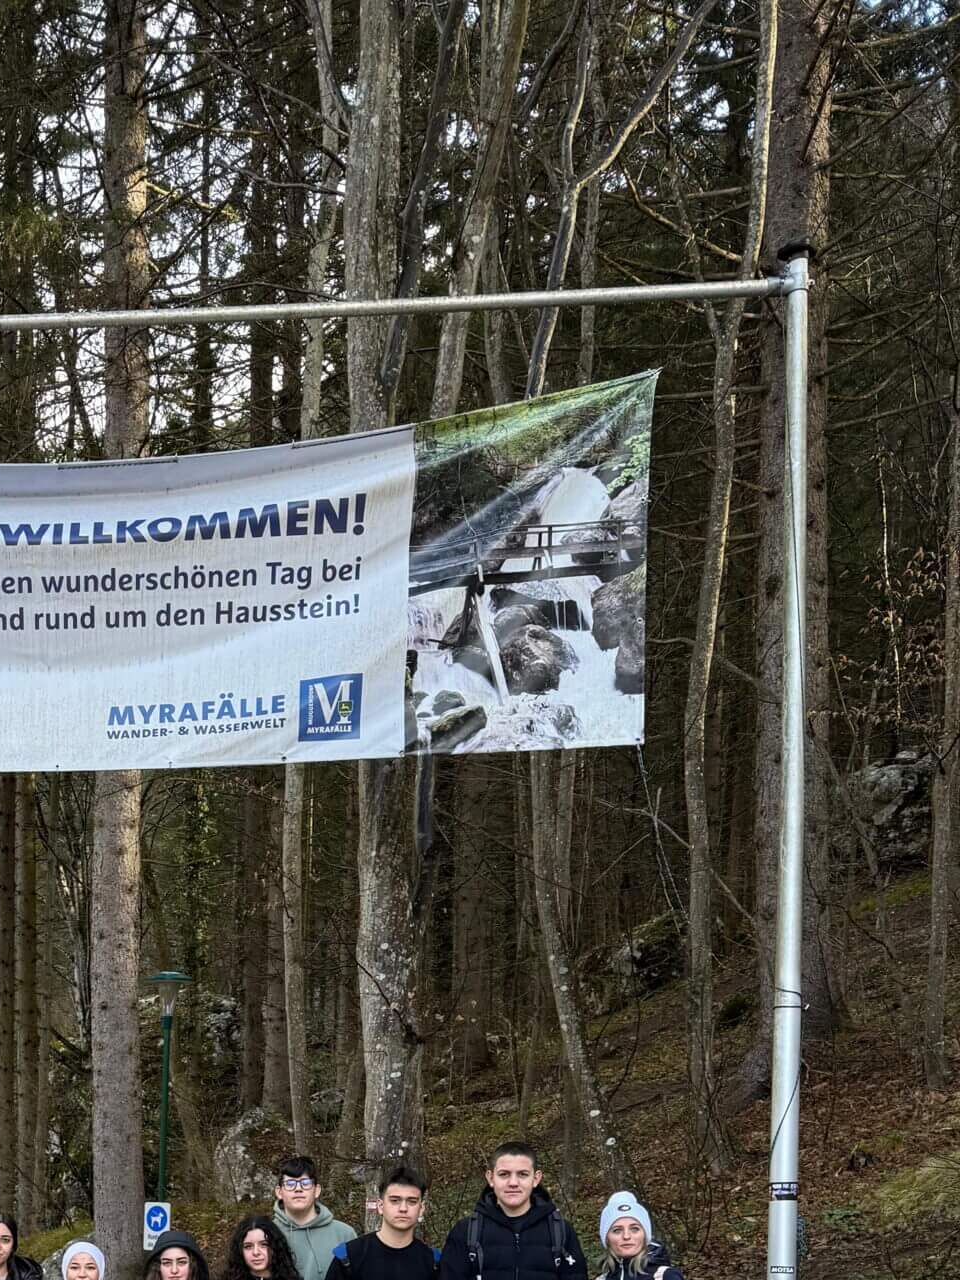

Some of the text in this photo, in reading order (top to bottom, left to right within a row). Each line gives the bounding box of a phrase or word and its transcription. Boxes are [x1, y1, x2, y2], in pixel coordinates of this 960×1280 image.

[42, 564, 257, 594] wunderschönen
[266, 560, 312, 589] Tag
[321, 556, 362, 582] bei
[34, 605, 96, 630] rund
[105, 609, 147, 629] um
[156, 603, 205, 628] den
[215, 593, 360, 625] Hausstein!
[107, 692, 286, 726] MYRAFÄLLE
[107, 717, 287, 740] WANDER- & WASSERWELT
[306, 725, 353, 735] MYRAFÄLLE
